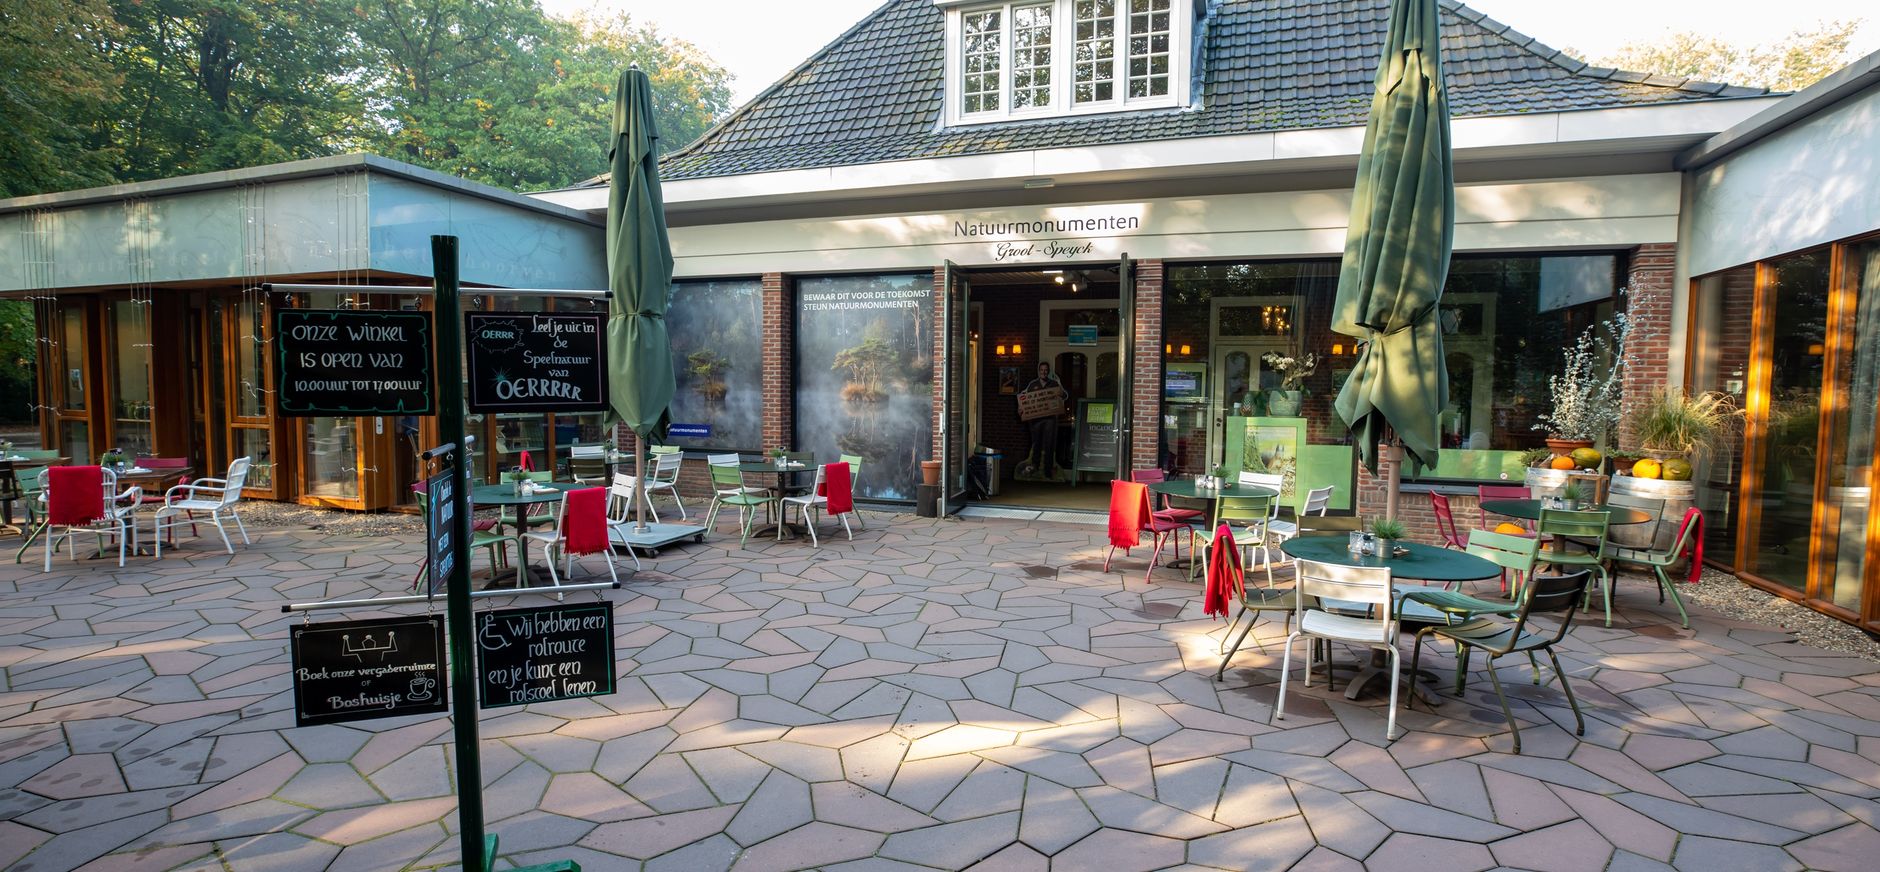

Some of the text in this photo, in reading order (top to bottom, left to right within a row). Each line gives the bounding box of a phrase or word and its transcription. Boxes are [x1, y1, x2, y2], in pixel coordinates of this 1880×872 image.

[954, 215, 1139, 237] Natuurmonumenten
[803, 289, 931, 301] BEWAAR DIT VOOR DE TOEKOMST
[803, 300, 919, 311] STEUN NATUURMONUMENTEN
[482, 330, 514, 339] OERRR
[531, 314, 595, 337] Leef je uit in
[553, 336, 568, 348] de
[548, 369, 570, 377] van
[496, 378, 583, 401] OERRRRR
[507, 611, 606, 640] Wij hebben een
[529, 637, 586, 658] rolroute
[296, 663, 436, 681] Boek onze vergaderruimte
[488, 660, 581, 690] en je kunt een
[510, 678, 597, 703] rolstoel lenen
[327, 692, 401, 709] Boshuisje
